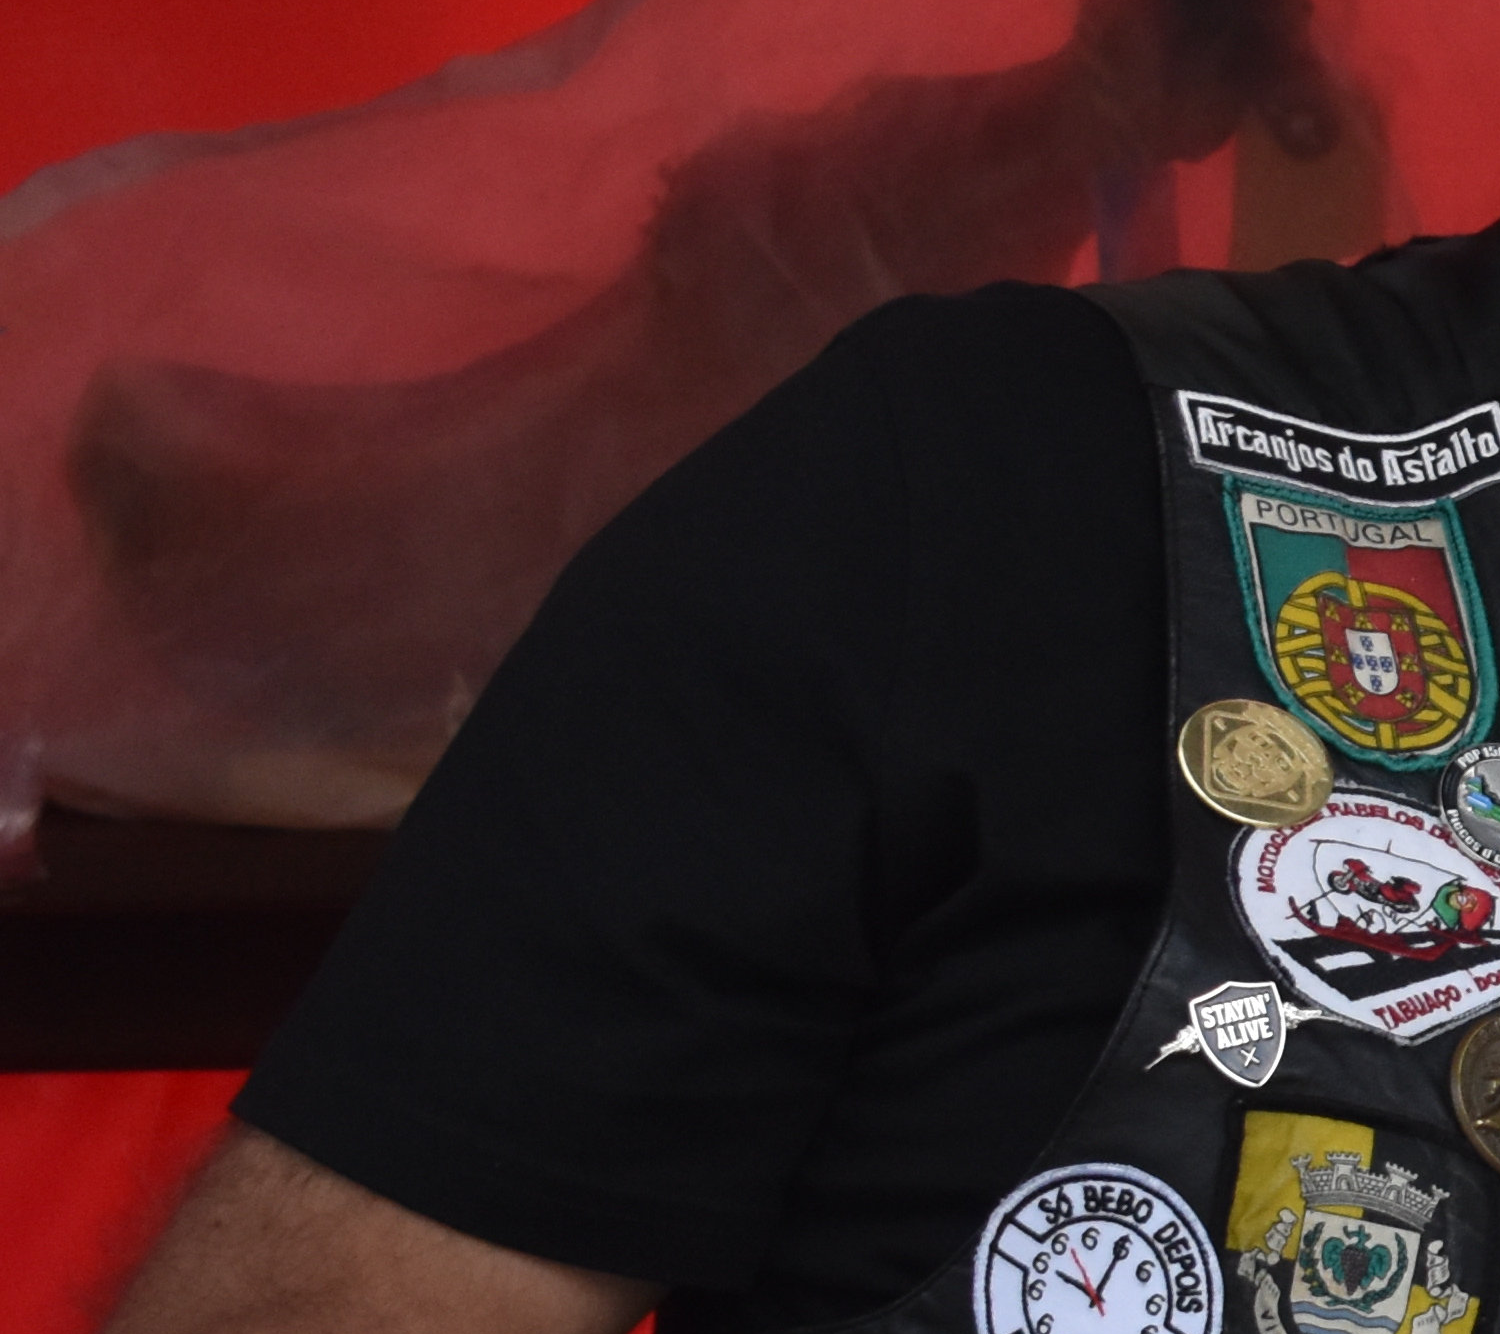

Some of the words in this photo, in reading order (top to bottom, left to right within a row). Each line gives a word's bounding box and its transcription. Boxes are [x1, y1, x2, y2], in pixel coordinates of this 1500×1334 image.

[1198, 407, 1335, 472] Arcanjos
[1338, 446, 1378, 483] do
[1381, 427, 1500, 487] Asfalto
[1257, 499, 1433, 544] PORTUGAL
[1200, 993, 1271, 1029] STAYIN'
[1372, 984, 1463, 1033] TABUAÇO
[1216, 1017, 1274, 1050] ALIVE
[1037, 1186, 1075, 1225] SÓ
[1082, 1184, 1155, 1225] BEBO
[1152, 1219, 1205, 1316] DEPOIS
[1051, 1233, 1071, 1256] 6
[1081, 1227, 1102, 1251] 6
[1032, 1251, 1053, 1275] 6
[1135, 1260, 1156, 1283] 6
[1027, 1279, 1047, 1302] 6
[1145, 1293, 1166, 1317] 6
